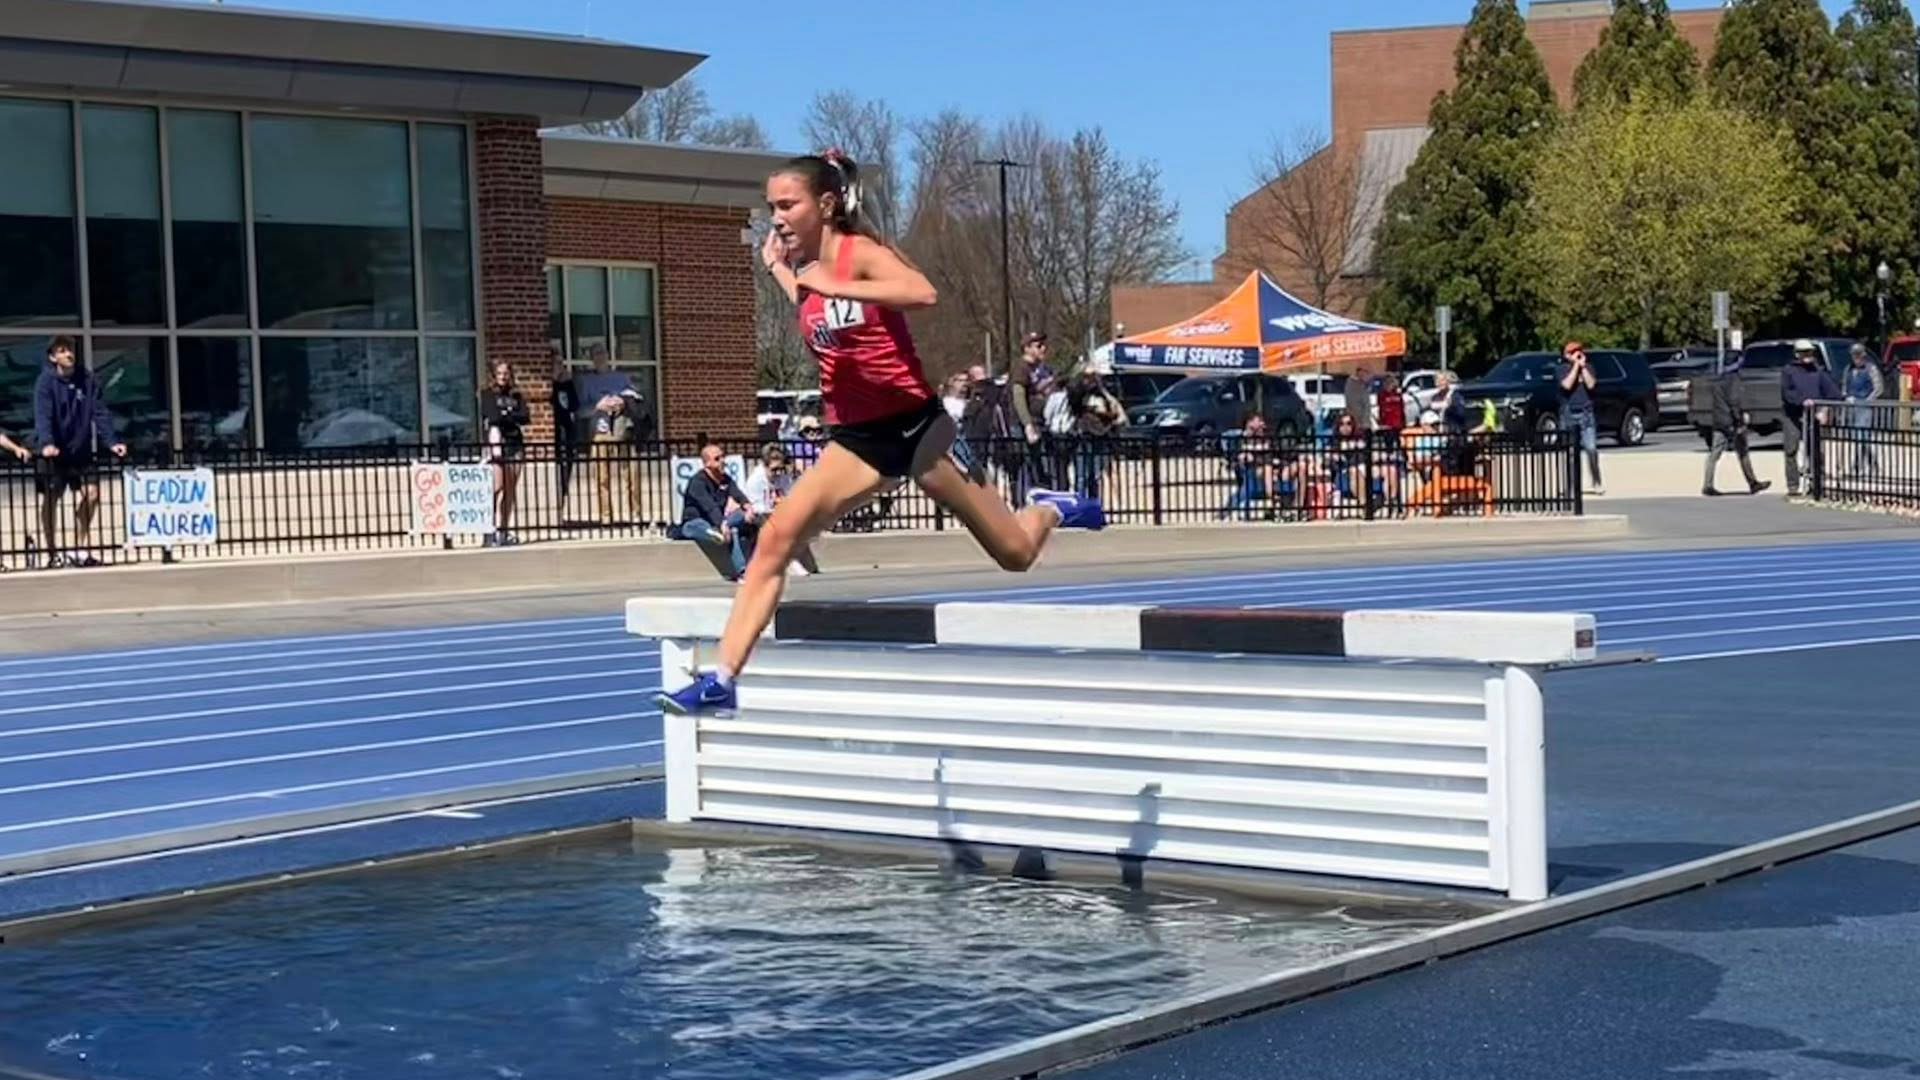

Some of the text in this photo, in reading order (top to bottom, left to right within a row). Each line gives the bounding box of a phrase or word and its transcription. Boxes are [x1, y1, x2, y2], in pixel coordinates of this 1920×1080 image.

[1164, 346, 1245, 366] FAN SERVICES
[1331, 334, 1386, 355] SERVICES
[130, 479, 207, 504] LEADIN
[130, 512, 214, 537] LAUREN
